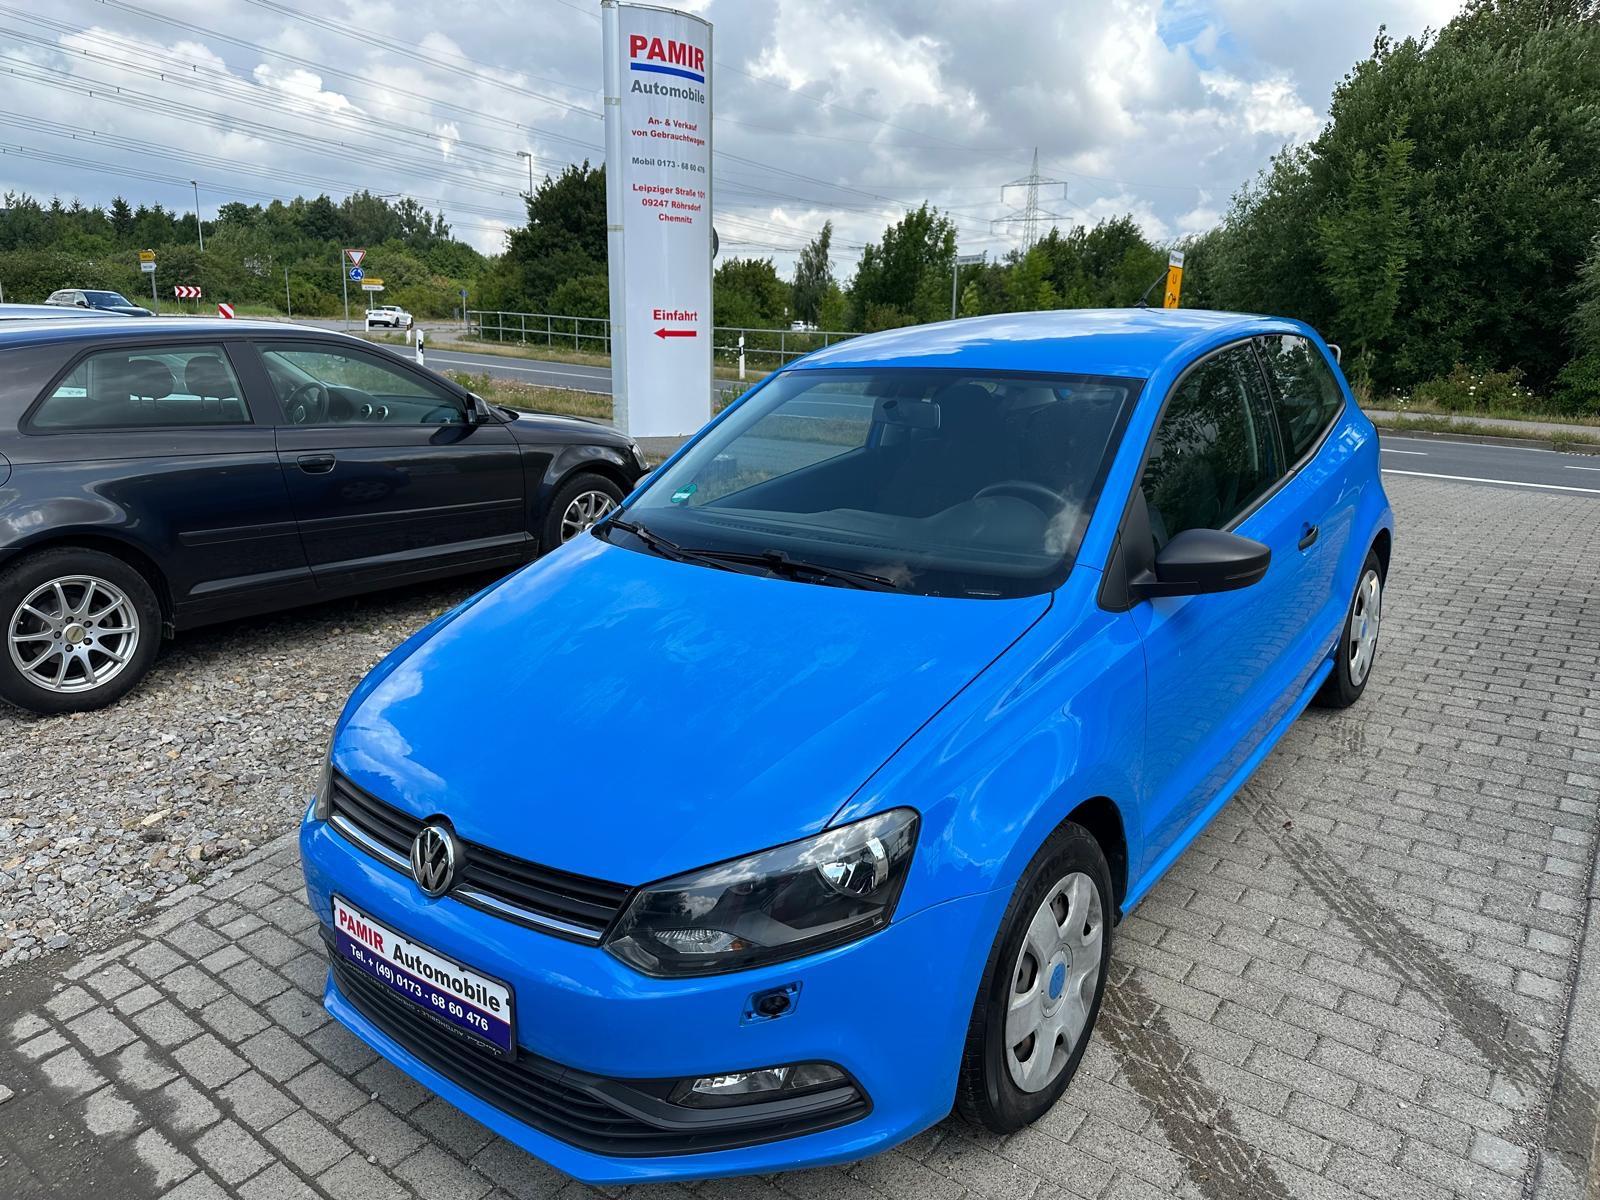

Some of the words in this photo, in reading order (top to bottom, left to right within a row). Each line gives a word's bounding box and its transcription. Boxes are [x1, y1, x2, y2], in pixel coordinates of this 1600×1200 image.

[630, 34, 704, 73] PAMIR
[631, 79, 705, 104] Automobile
[648, 116, 662, 125] An-
[664, 118, 671, 127] &
[673, 119, 698, 131] Verkauf
[631, 129, 648, 137] von
[650, 129, 705, 146] Gebrauchtwagen
[632, 157, 655, 166] Mobil
[657, 159, 676, 168] 0173
[681, 162, 689, 170] 68
[690, 163, 697, 172] 60
[632, 183, 673, 195] Leipziger
[675, 186, 696, 197] Straße
[697, 190, 705, 199] 101
[642, 198, 669, 208] 09247
[671, 200, 701, 212] Röhrsdorf
[658, 213, 692, 224] Chemnitz
[653, 309, 698, 322] Einfahrt
[339, 907, 385, 954] PAMIR
[393, 943, 501, 1012] Automobile
[350, 943, 366, 964] Tel.
[368, 957, 374, 967] +
[375, 961, 394, 984] (49)
[397, 974, 422, 998] 0173
[431, 993, 446, 1010] 68
[448, 1001, 463, 1018] 60
[466, 1011, 489, 1031] 476
